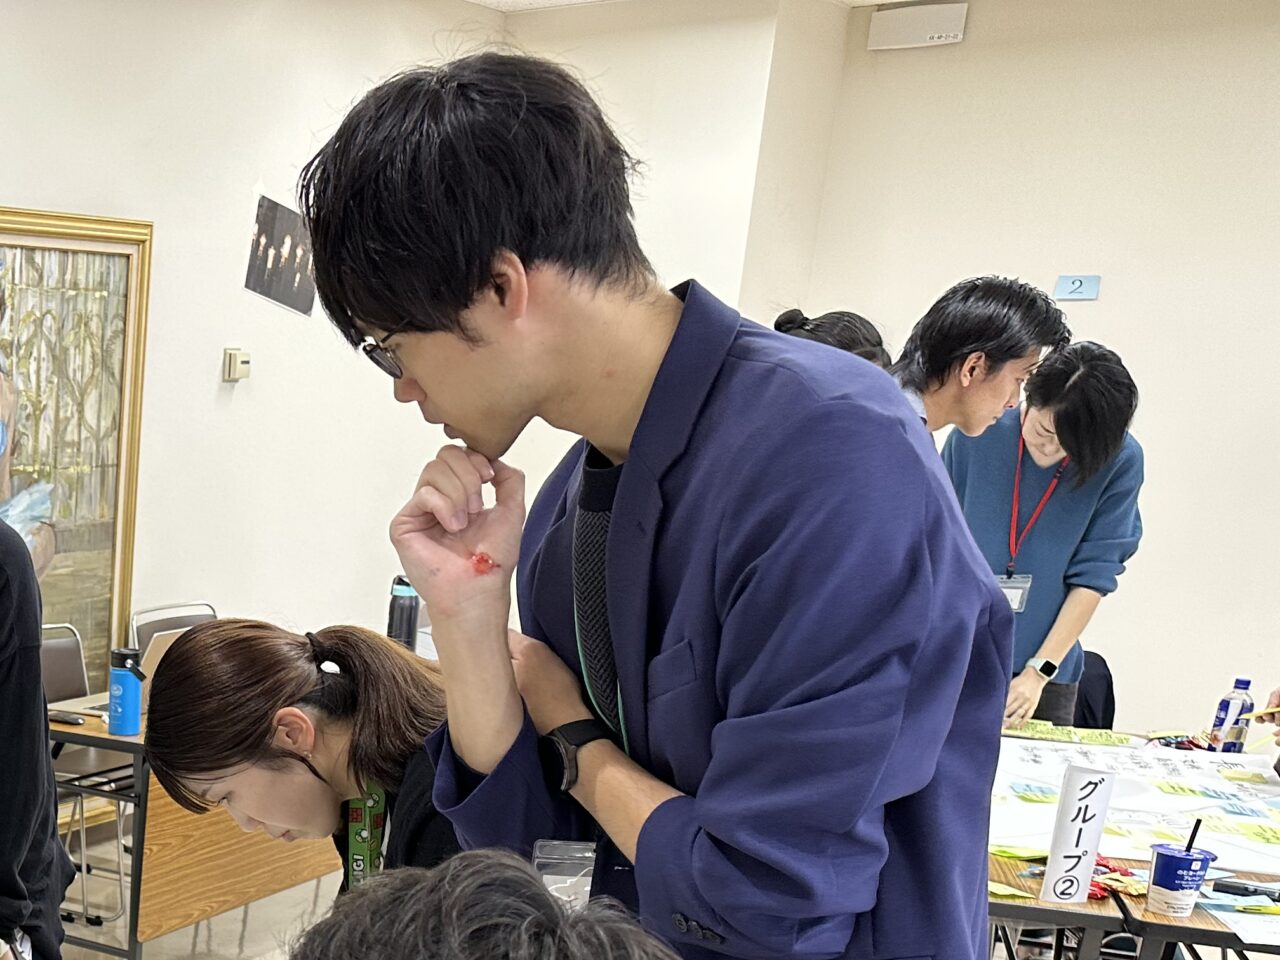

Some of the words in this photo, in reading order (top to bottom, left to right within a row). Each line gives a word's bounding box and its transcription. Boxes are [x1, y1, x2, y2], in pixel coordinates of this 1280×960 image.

[1069, 279, 1084, 295] 2
[1053, 777, 1105, 901] グループ②
